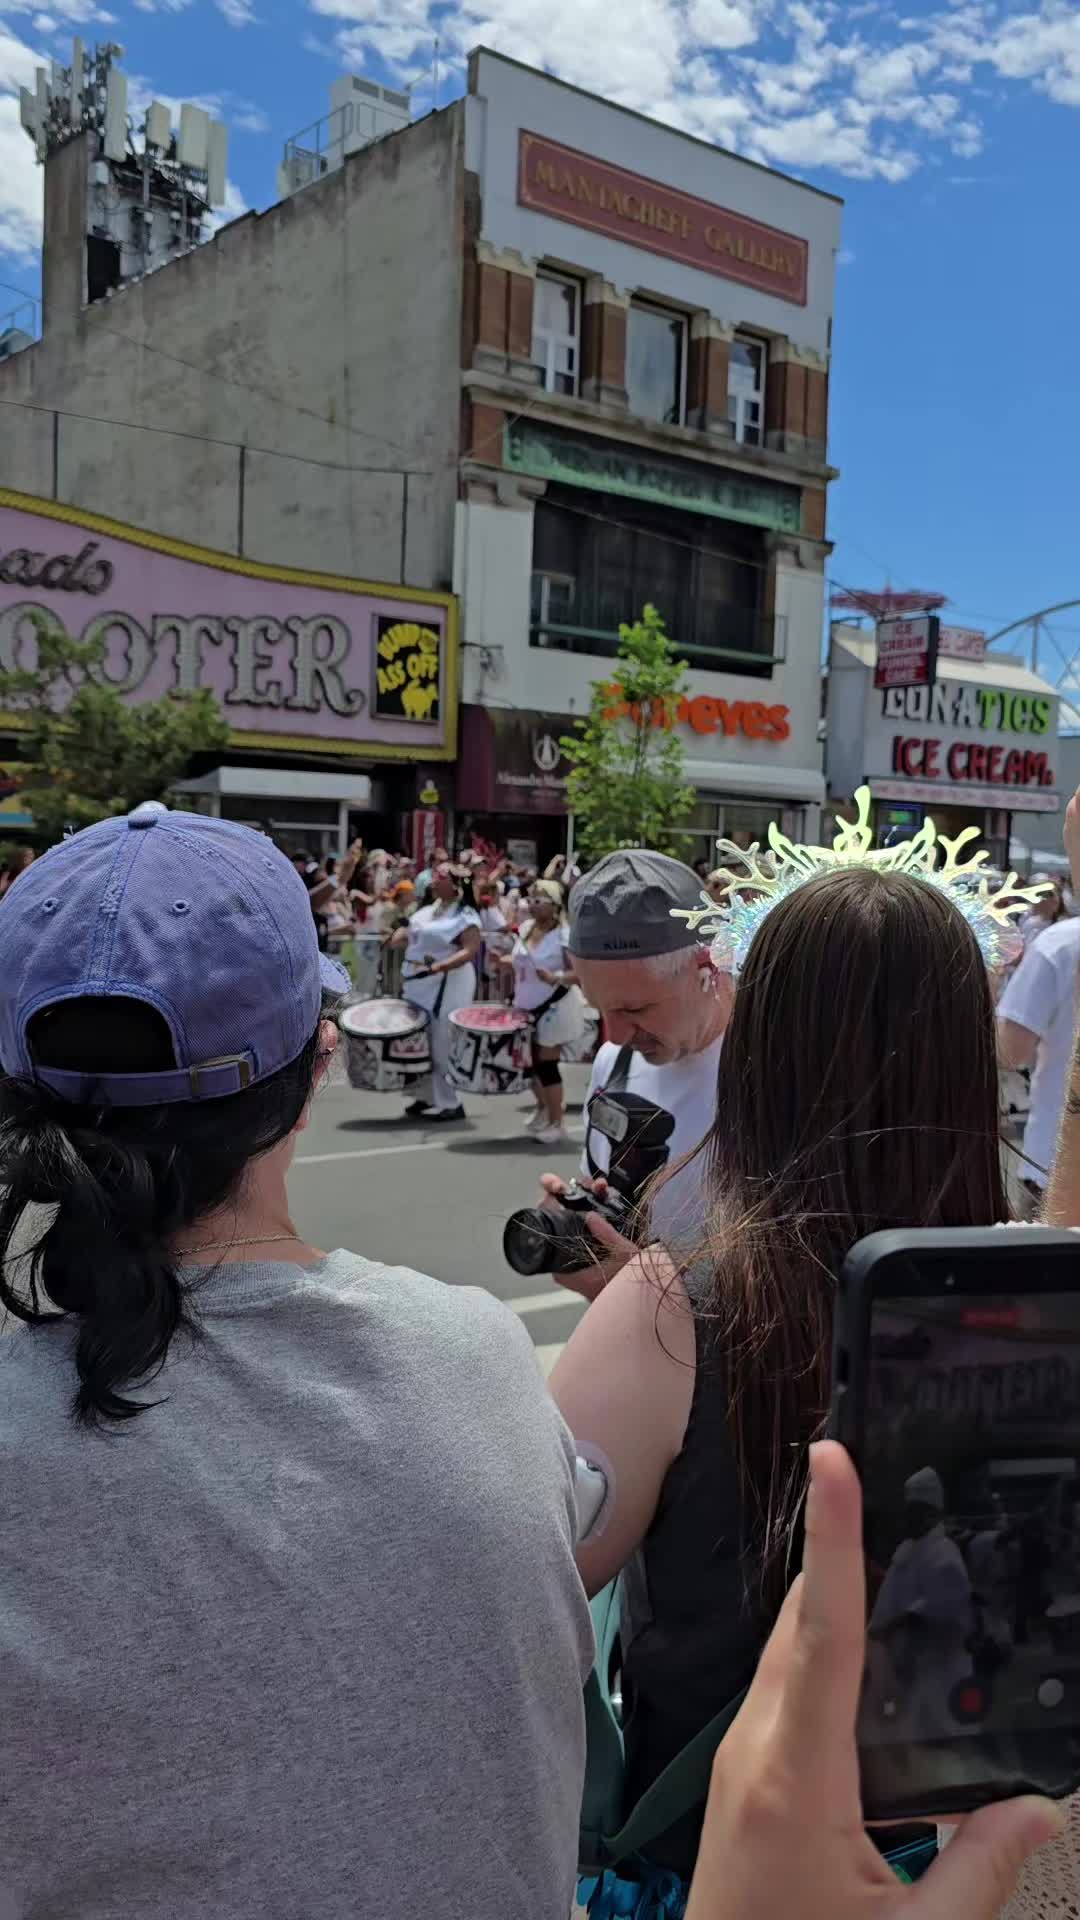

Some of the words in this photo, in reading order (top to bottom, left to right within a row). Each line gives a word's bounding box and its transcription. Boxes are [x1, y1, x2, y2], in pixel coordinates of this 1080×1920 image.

[377, 660, 406, 694] ASS
[407, 654, 438, 680] OFF
[892, 736, 942, 777] ICE
